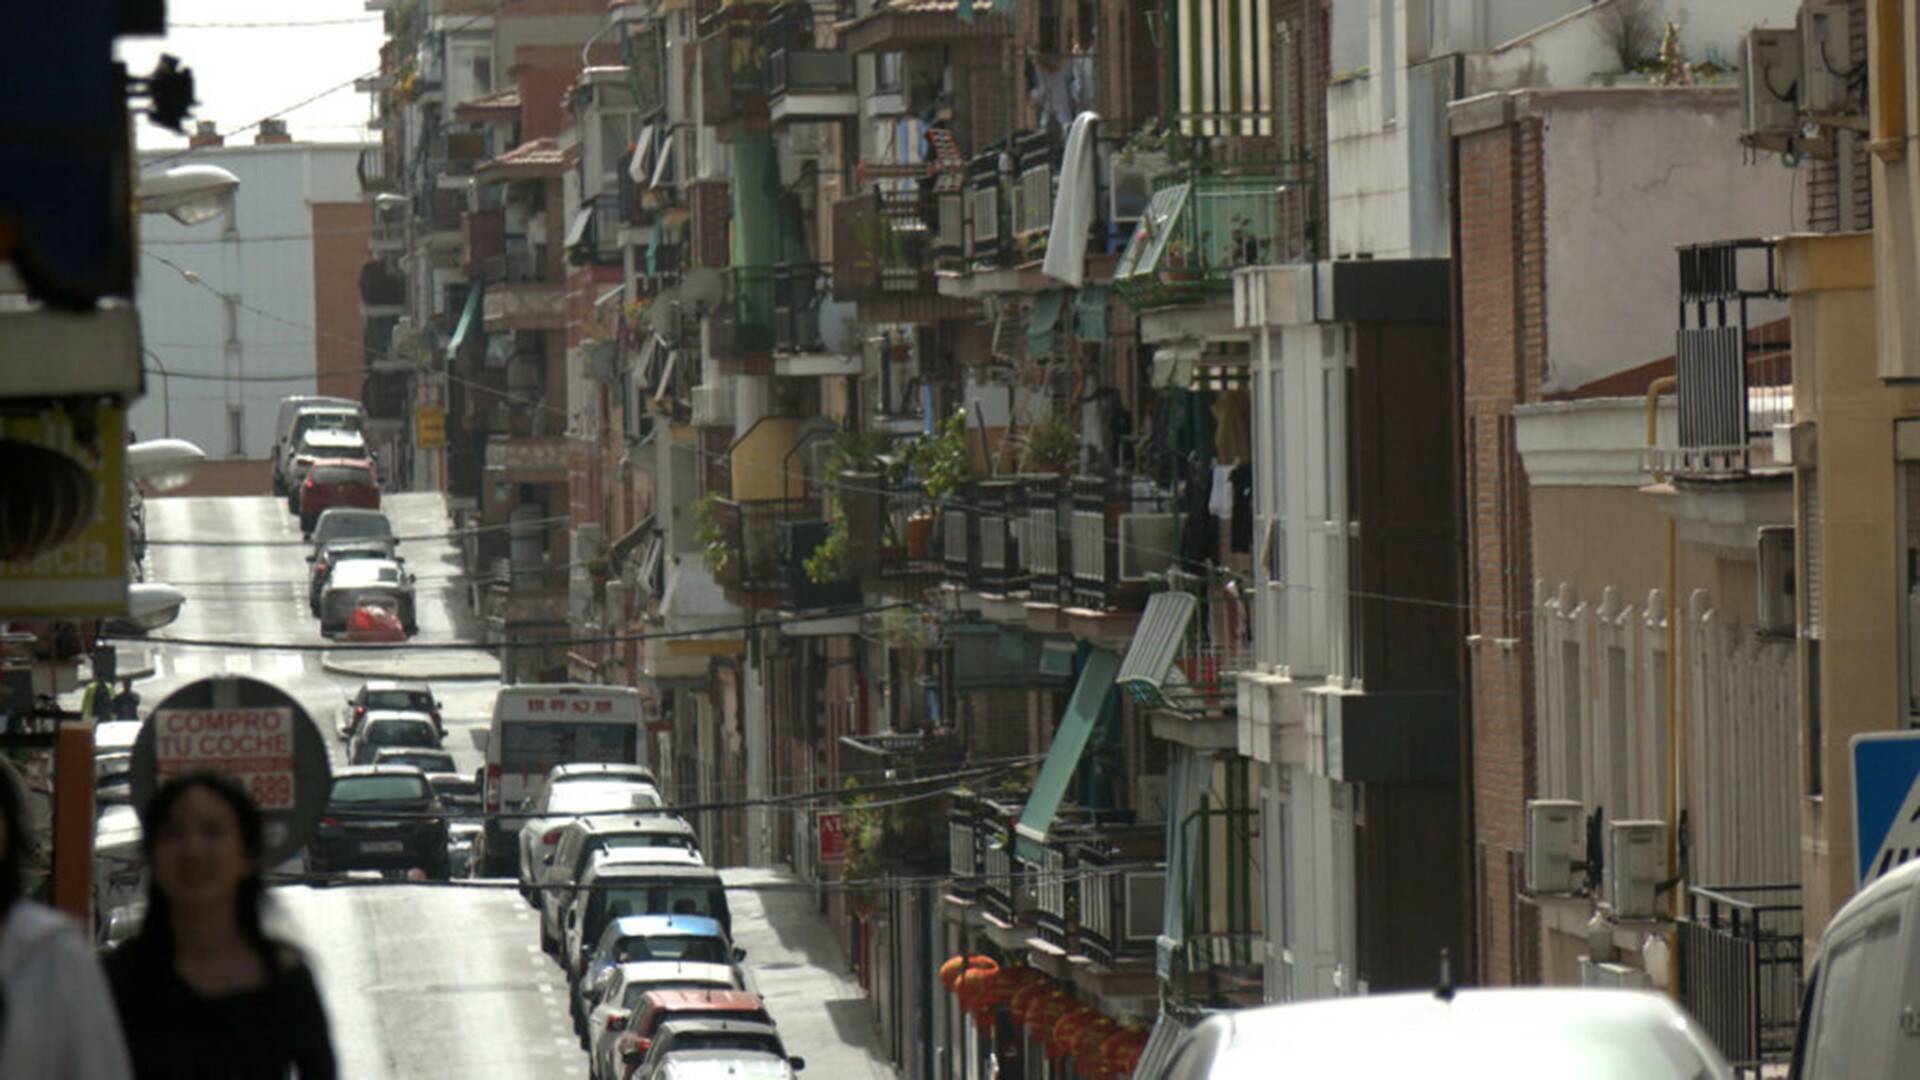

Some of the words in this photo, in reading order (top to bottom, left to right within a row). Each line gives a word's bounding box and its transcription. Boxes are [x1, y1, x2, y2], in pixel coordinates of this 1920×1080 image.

[167, 711, 281, 733] COMPRO
[160, 736, 191, 755] TU
[199, 734, 288, 755] COCHE
